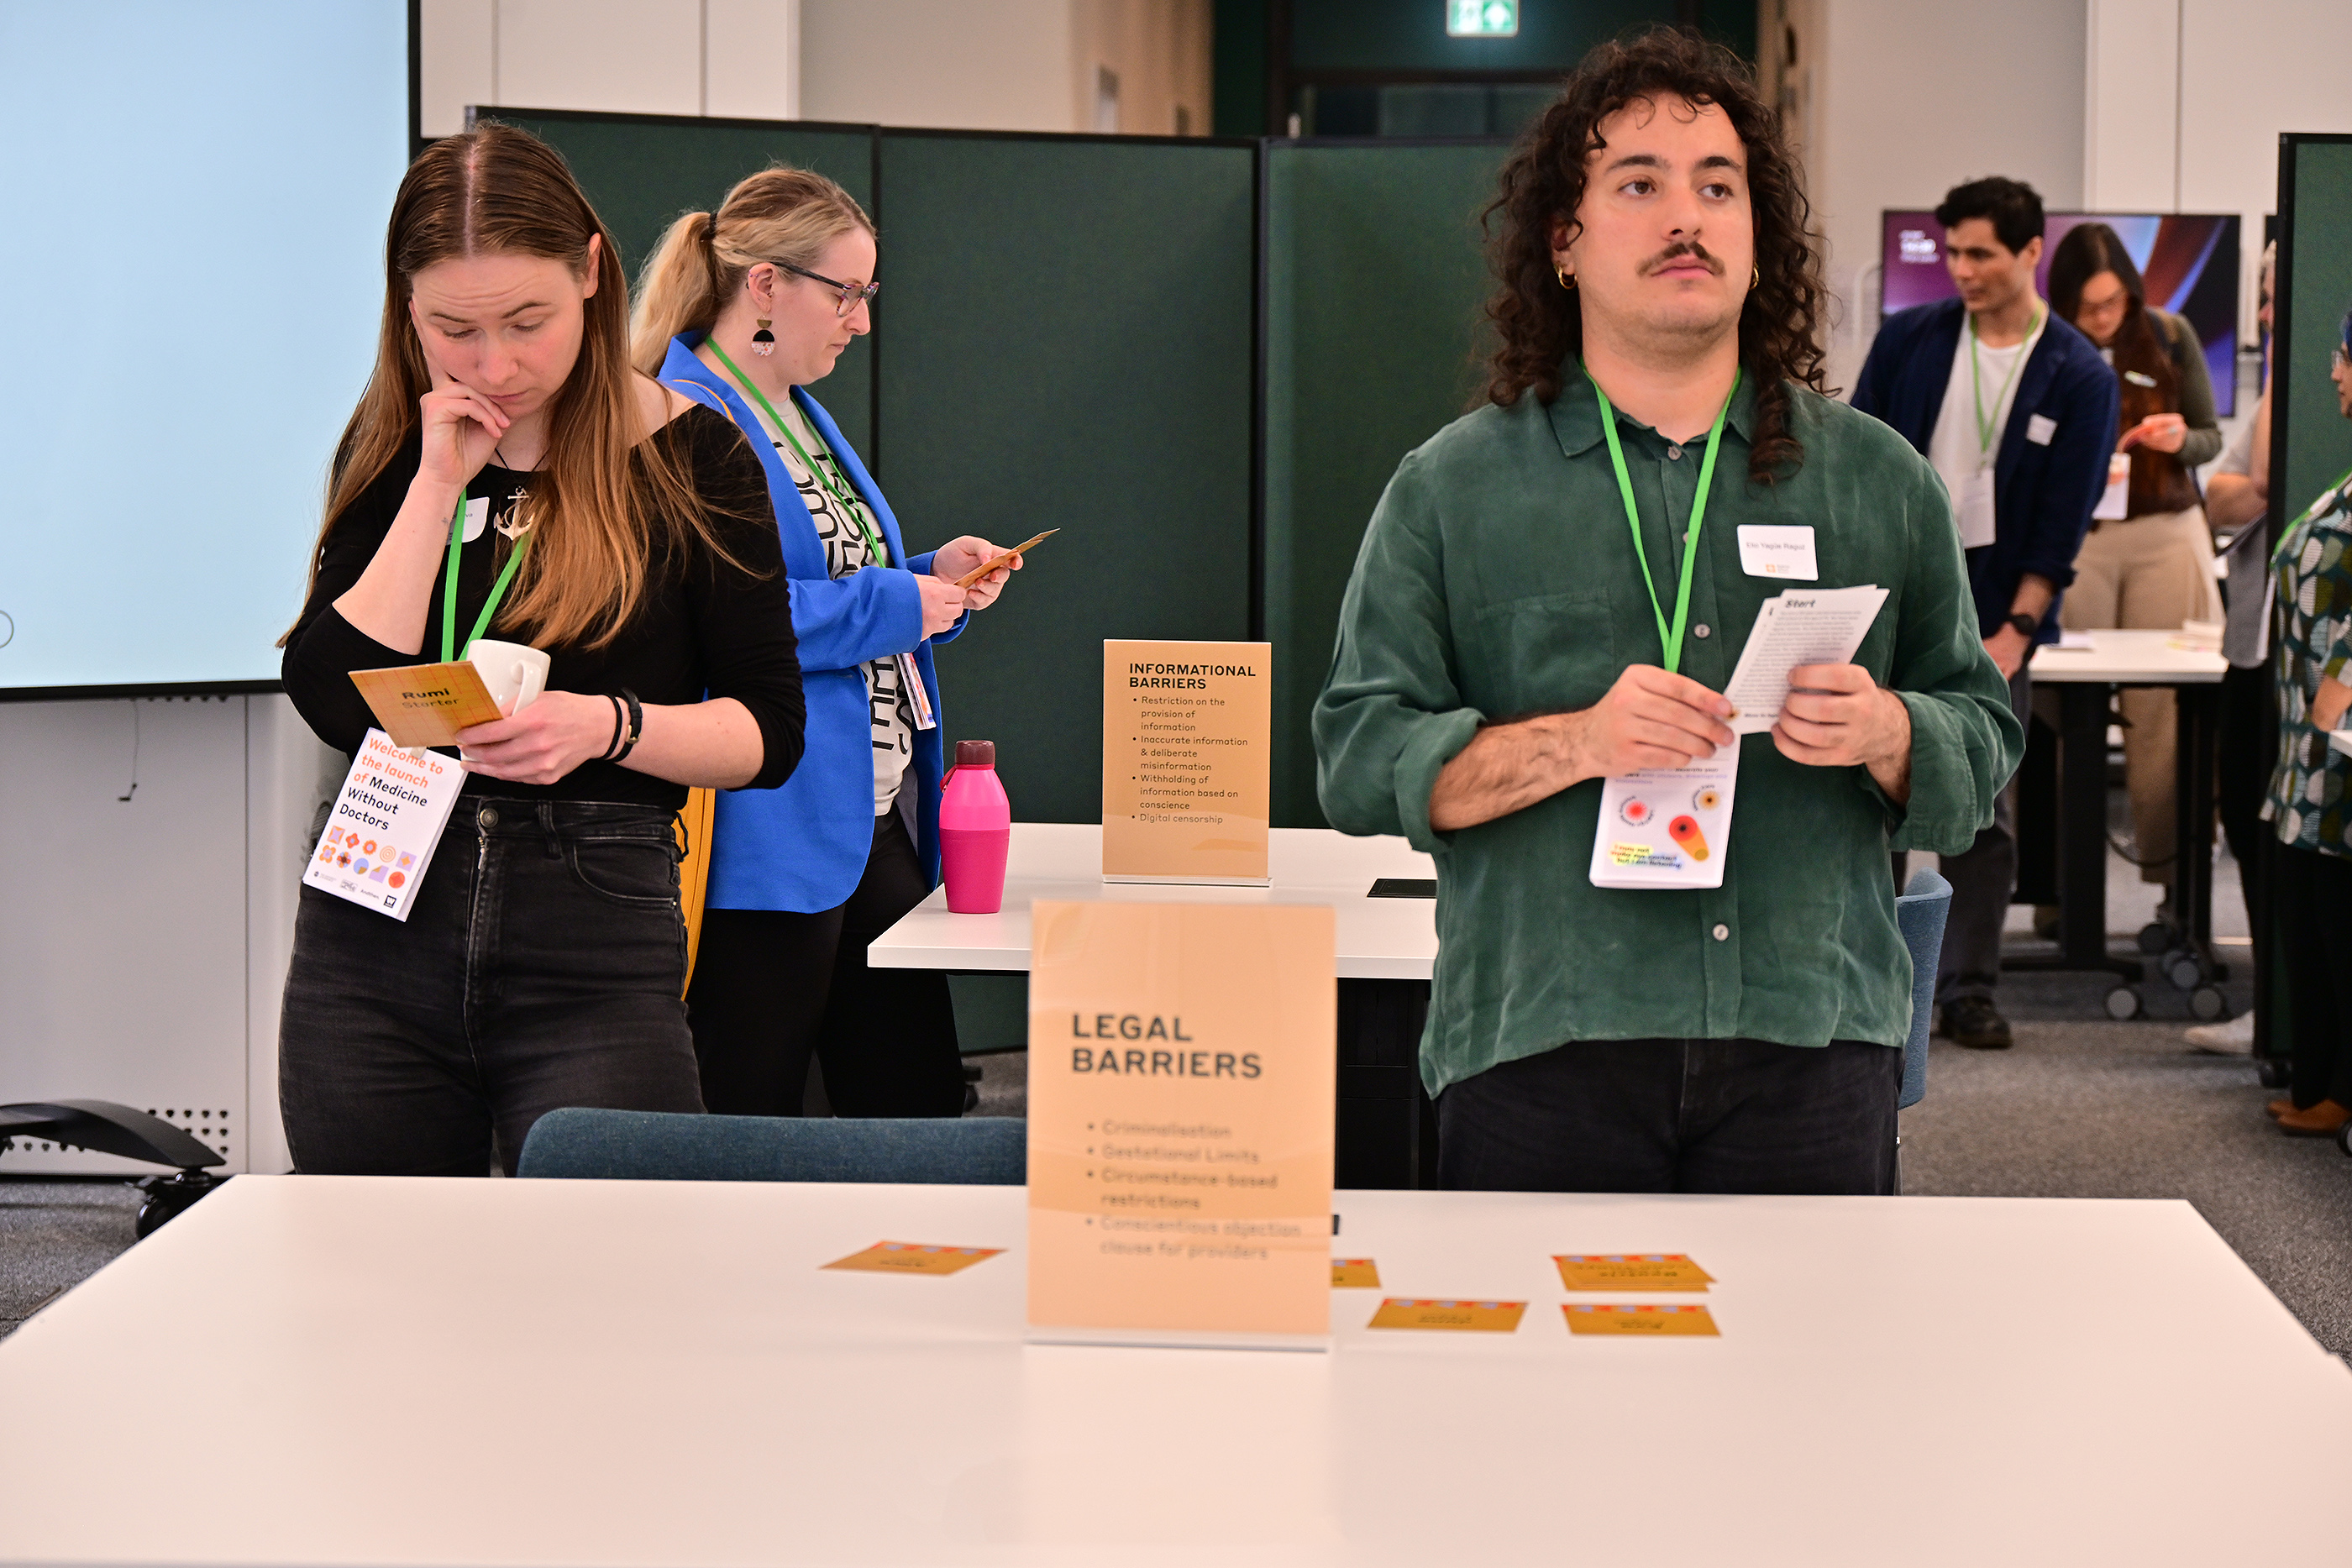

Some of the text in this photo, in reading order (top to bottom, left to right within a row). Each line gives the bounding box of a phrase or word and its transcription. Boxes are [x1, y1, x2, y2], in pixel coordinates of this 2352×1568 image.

[1129, 663, 1257, 677] INFORMATIONAL
[1129, 677, 1207, 690] BARRIERS
[402, 688, 450, 700] Rumi
[1142, 695, 1194, 705] Restriction
[1210, 697, 1226, 706] the
[402, 698, 460, 709] Starter
[1141, 710, 1196, 719] provision of
[1141, 722, 1196, 732] information
[1141, 735, 1248, 746] Inaccurate information
[369, 737, 444, 774] Welcome to
[1140, 748, 1198, 758] & deliberate
[361, 754, 428, 788] the launch
[1140, 762, 1212, 771] misinformation
[1140, 774, 1210, 785] Withholding of
[354, 773, 428, 807] of Medicine
[1140, 787, 1195, 797] information
[1197, 789, 1225, 798] based
[348, 787, 400, 815] Without
[1139, 800, 1190, 810] conscience
[339, 803, 390, 831] Doctors
[1139, 813, 1224, 825] Digital censorship
[1072, 1013, 1193, 1043] LEGAL
[1071, 1046, 1263, 1080] BARRIERS
[1102, 1120, 1232, 1139] Criminalisation
[1101, 1145, 1259, 1165] Gestational Limits
[1101, 1170, 1278, 1189] Circumstance-based
[1100, 1193, 1201, 1210] restrictions
[1100, 1215, 1302, 1240] Conscientious objection
[1099, 1240, 1268, 1261] clause for providers
